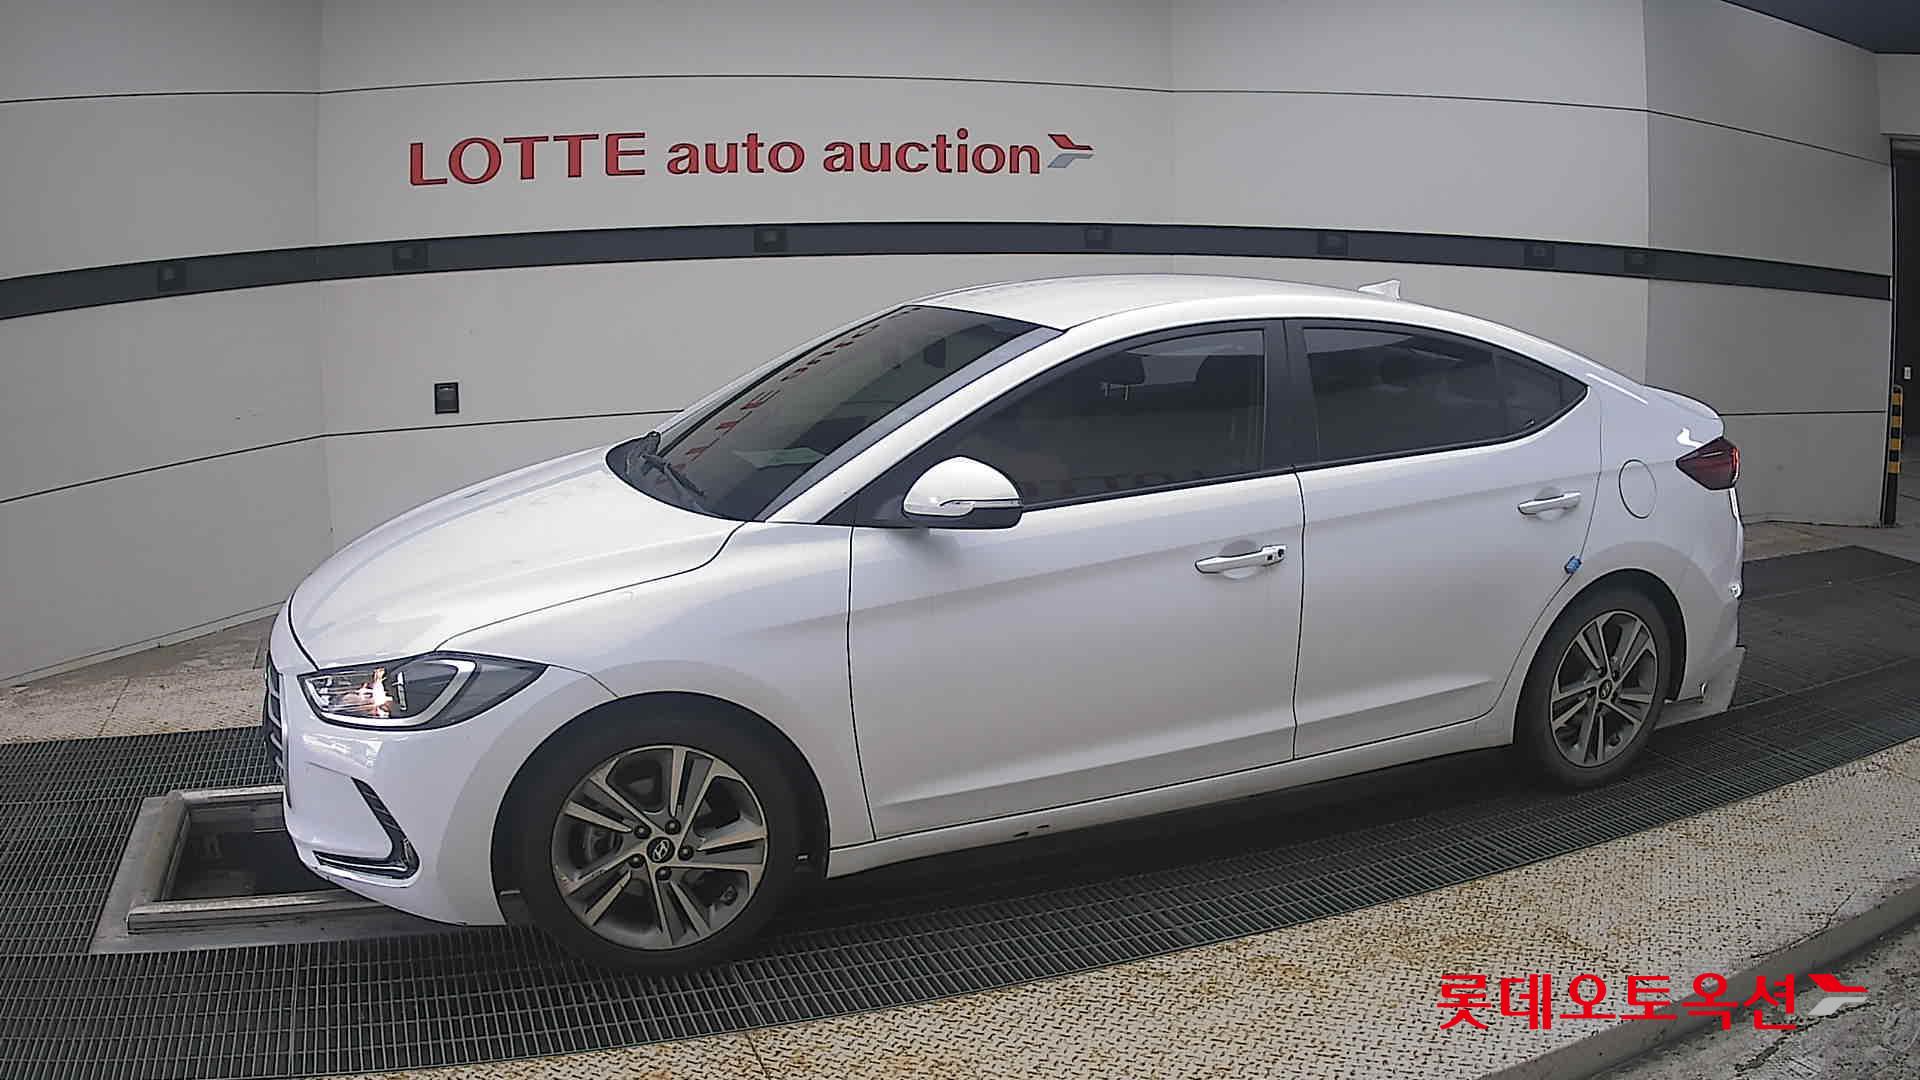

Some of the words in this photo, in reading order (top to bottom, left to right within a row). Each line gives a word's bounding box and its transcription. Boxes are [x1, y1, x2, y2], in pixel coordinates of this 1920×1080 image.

[409, 132, 647, 187] LOTTE
[666, 132, 806, 176] auto
[823, 128, 1041, 176] auction
